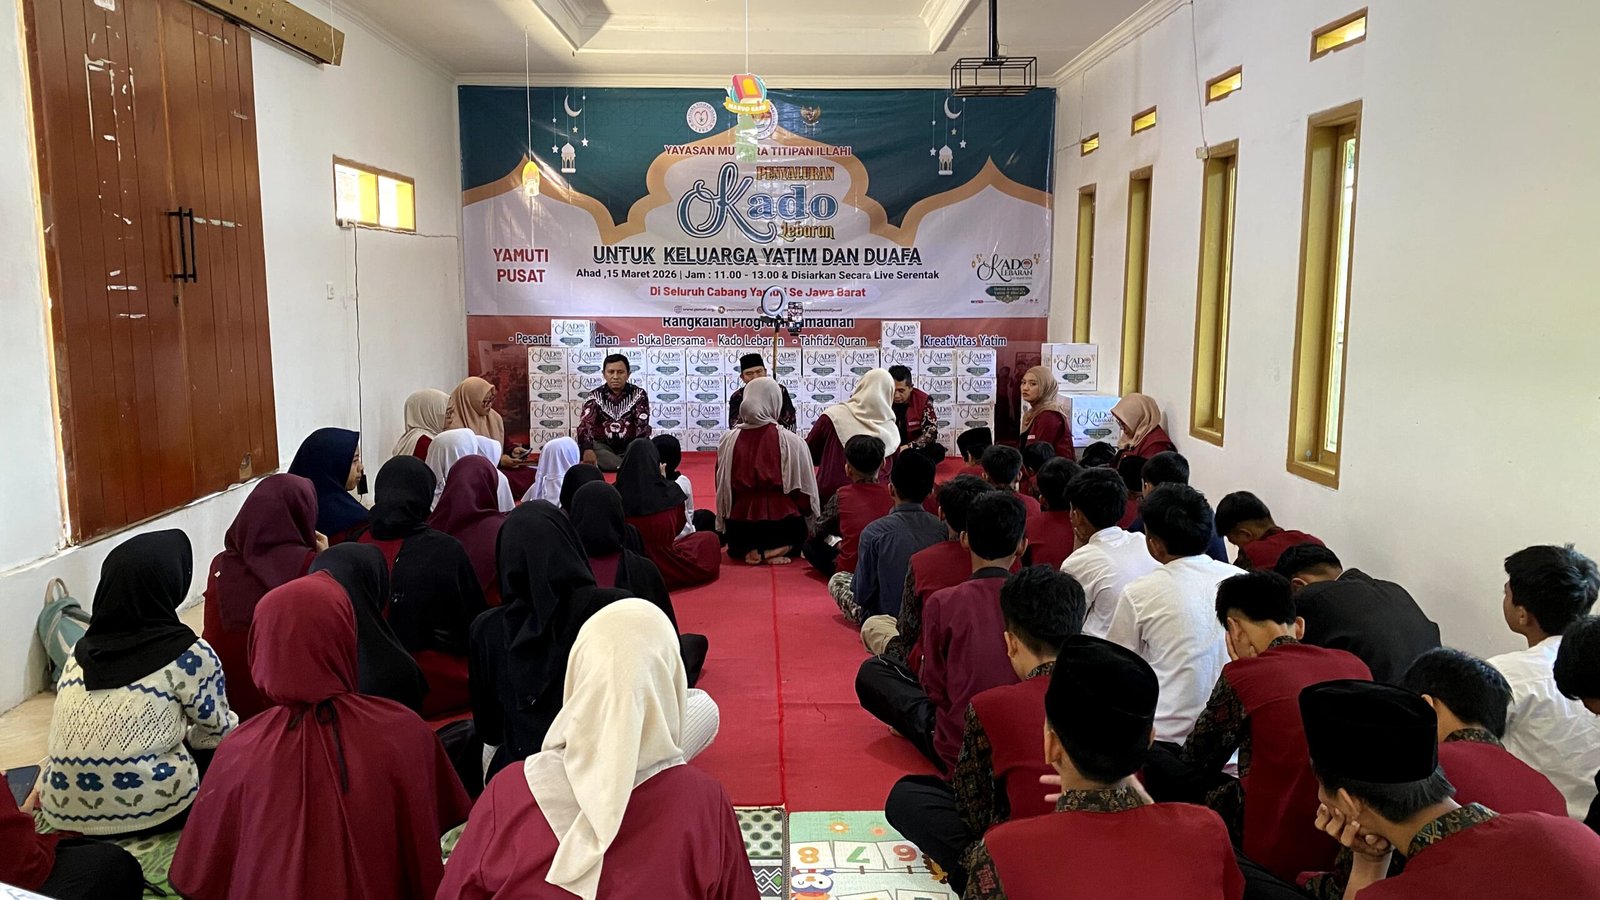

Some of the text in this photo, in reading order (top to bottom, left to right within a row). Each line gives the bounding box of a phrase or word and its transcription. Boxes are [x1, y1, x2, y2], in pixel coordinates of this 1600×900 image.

[663, 145, 851, 157] YAYASAN MURA TITIPAN ILLAHI
[756, 165, 835, 181] PENYALURAN
[677, 162, 838, 244] Kado
[777, 221, 836, 240] Lebaran
[493, 248, 549, 263] YAMUTI
[593, 245, 922, 266] UNTUK KELUARGA YATIM DAN DUAFA
[496, 268, 546, 283] PUSAT
[576, 269, 601, 278] Ahad
[621, 269, 650, 278] Maret
[652, 269, 677, 279] 2026
[684, 270, 706, 280] Jam
[713, 269, 741, 280] 11.00
[751, 270, 780, 280] 13.00
[781, 270, 789, 280] &
[791, 270, 837, 280] Disiarkan
[839, 271, 872, 281] Secara
[874, 270, 894, 280] Live
[896, 270, 940, 280] Serentak
[977, 254, 1033, 282] KADO
[1001, 269, 1033, 277] LEBARAN
[650, 286, 661, 297] Di
[663, 286, 705, 297] Seluruh
[707, 286, 748, 299] Cabang
[789, 287, 803, 297] Se
[805, 287, 834, 297] Jawa
[837, 287, 866, 297] Barat
[638, 334, 663, 345] Buka
[664, 335, 705, 345] Bersama
[718, 335, 743, 346] Kado
[745, 335, 784, 346] Lebarn
[799, 335, 834, 346] Tahfidz
[837, 336, 867, 347] Quran
[923, 335, 977, 346] Kreativitas
[979, 335, 1007, 346] Yatim
